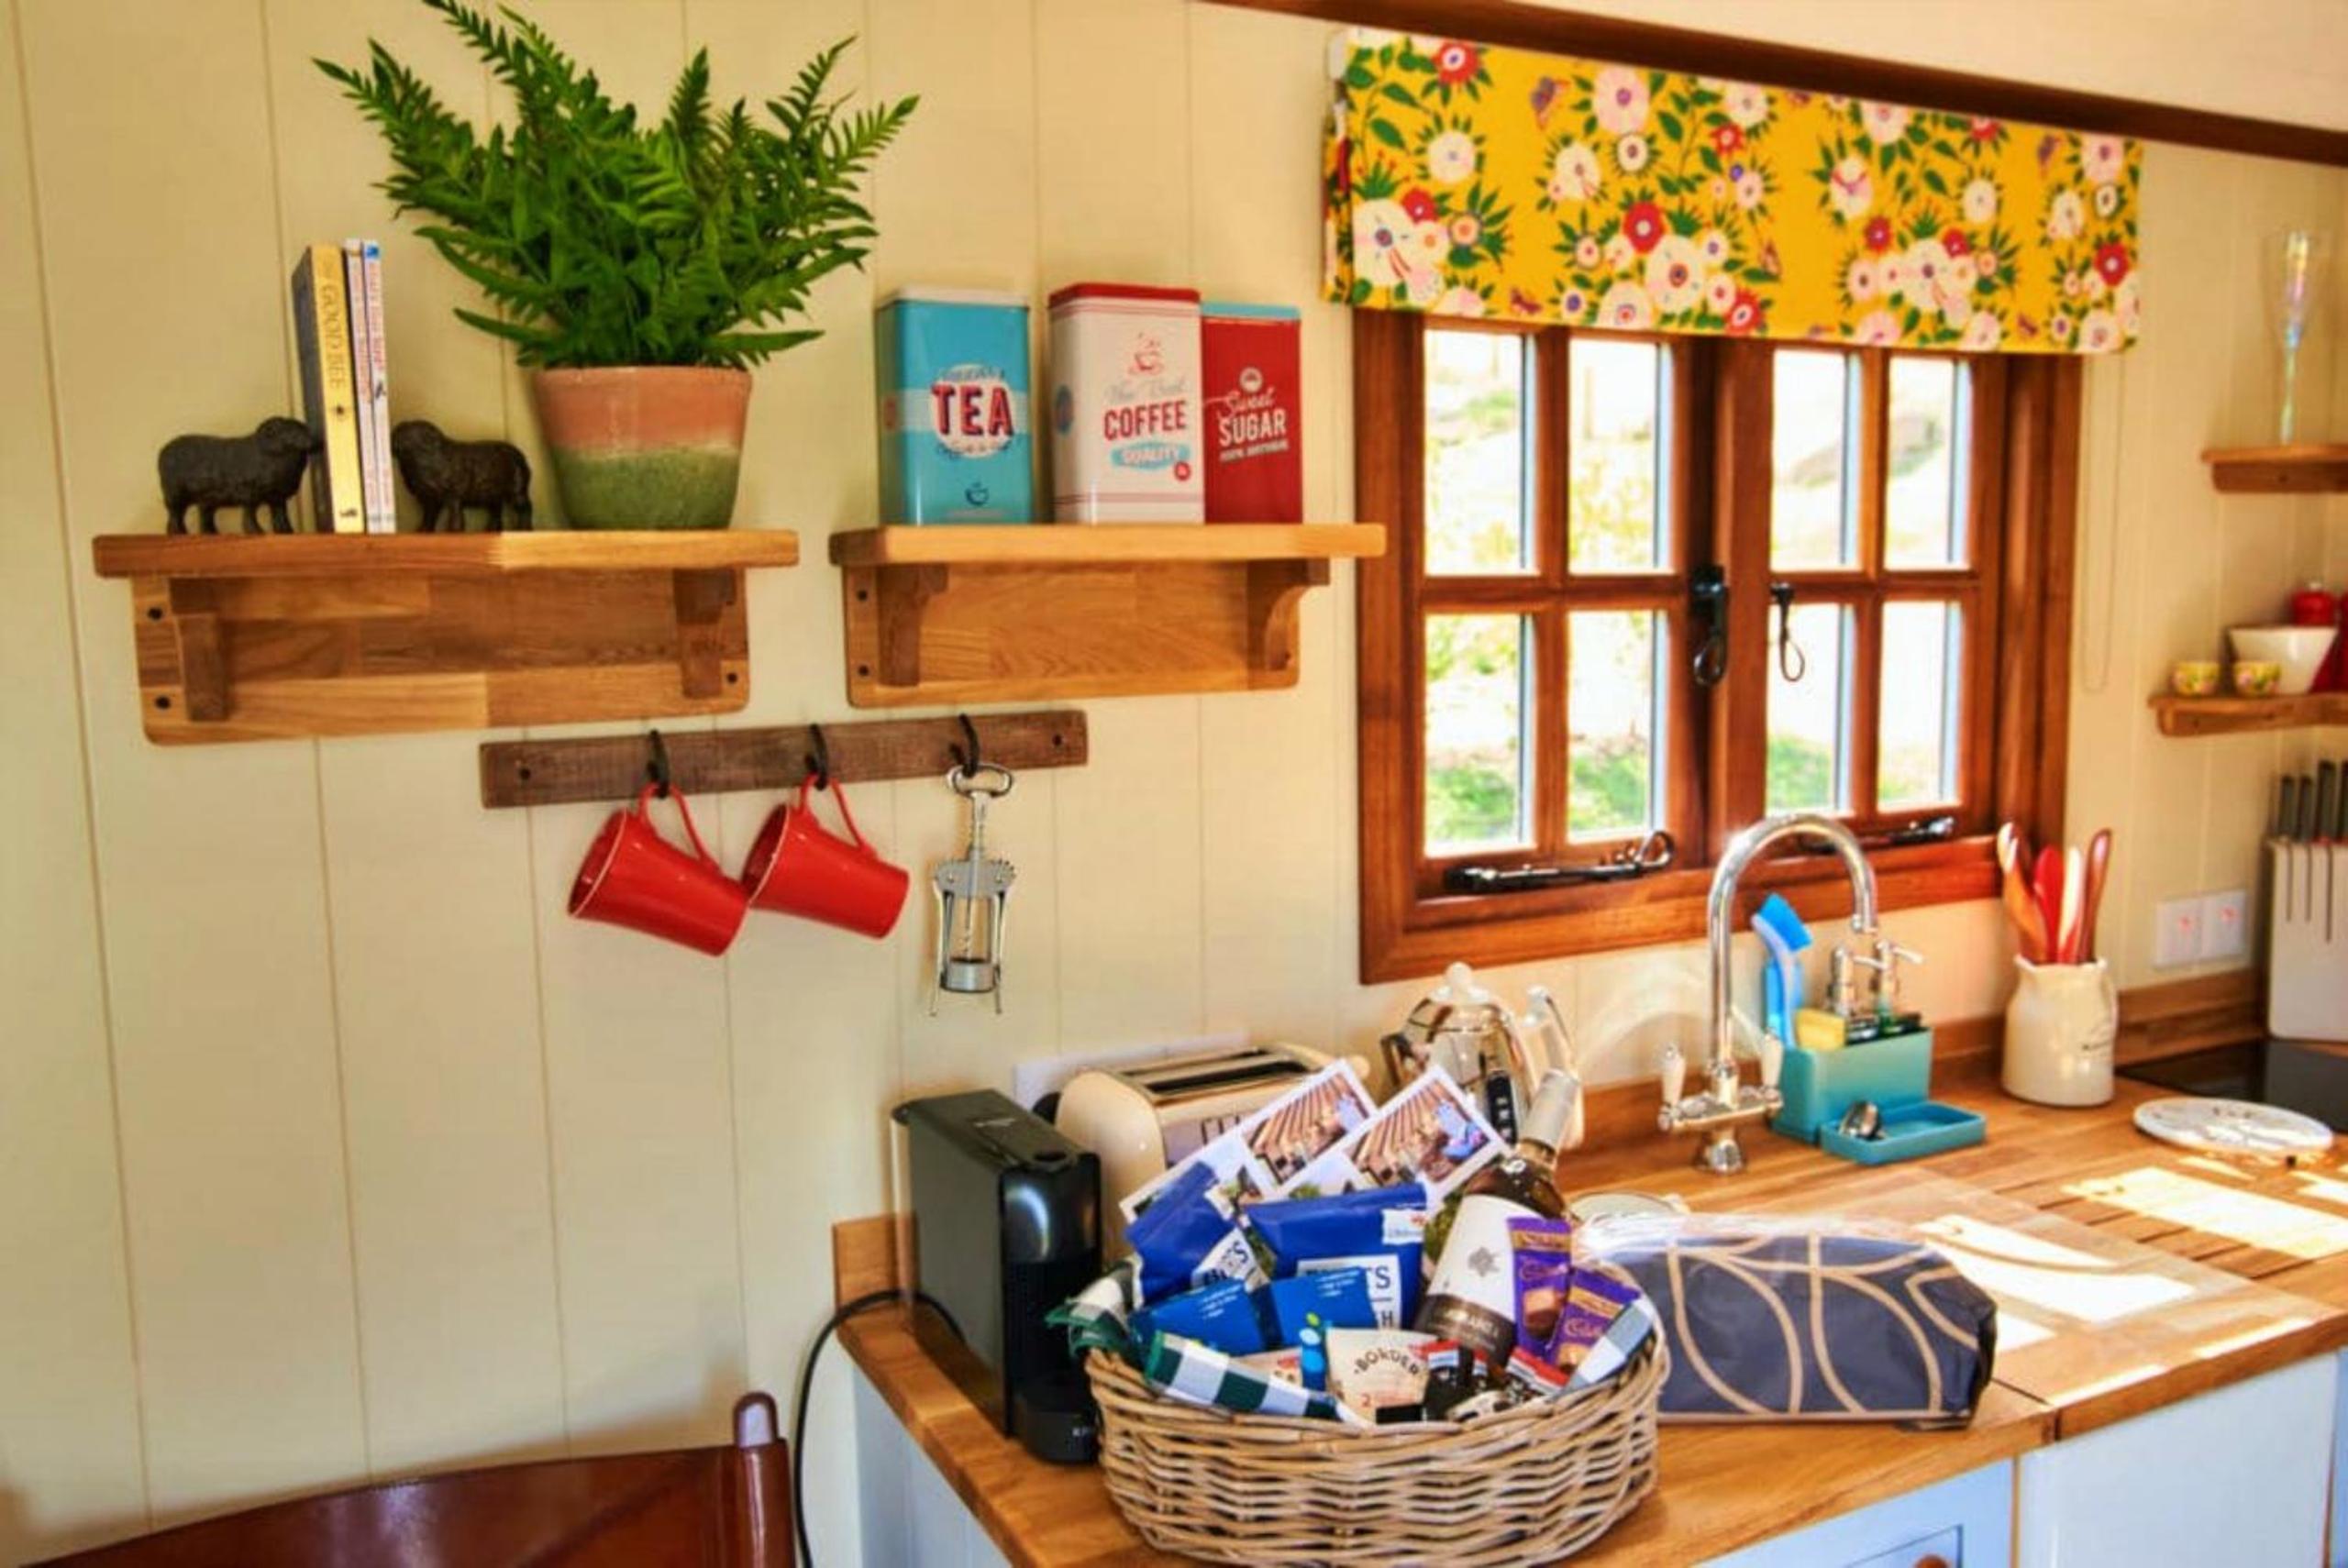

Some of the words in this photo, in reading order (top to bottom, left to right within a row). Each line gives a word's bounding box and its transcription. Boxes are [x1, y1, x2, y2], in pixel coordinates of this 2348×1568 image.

[320, 284, 343, 349] GOOD
[931, 383, 1014, 436] TEA
[1103, 400, 1187, 441] COFFEE
[1218, 408, 1287, 447] SUGAR
